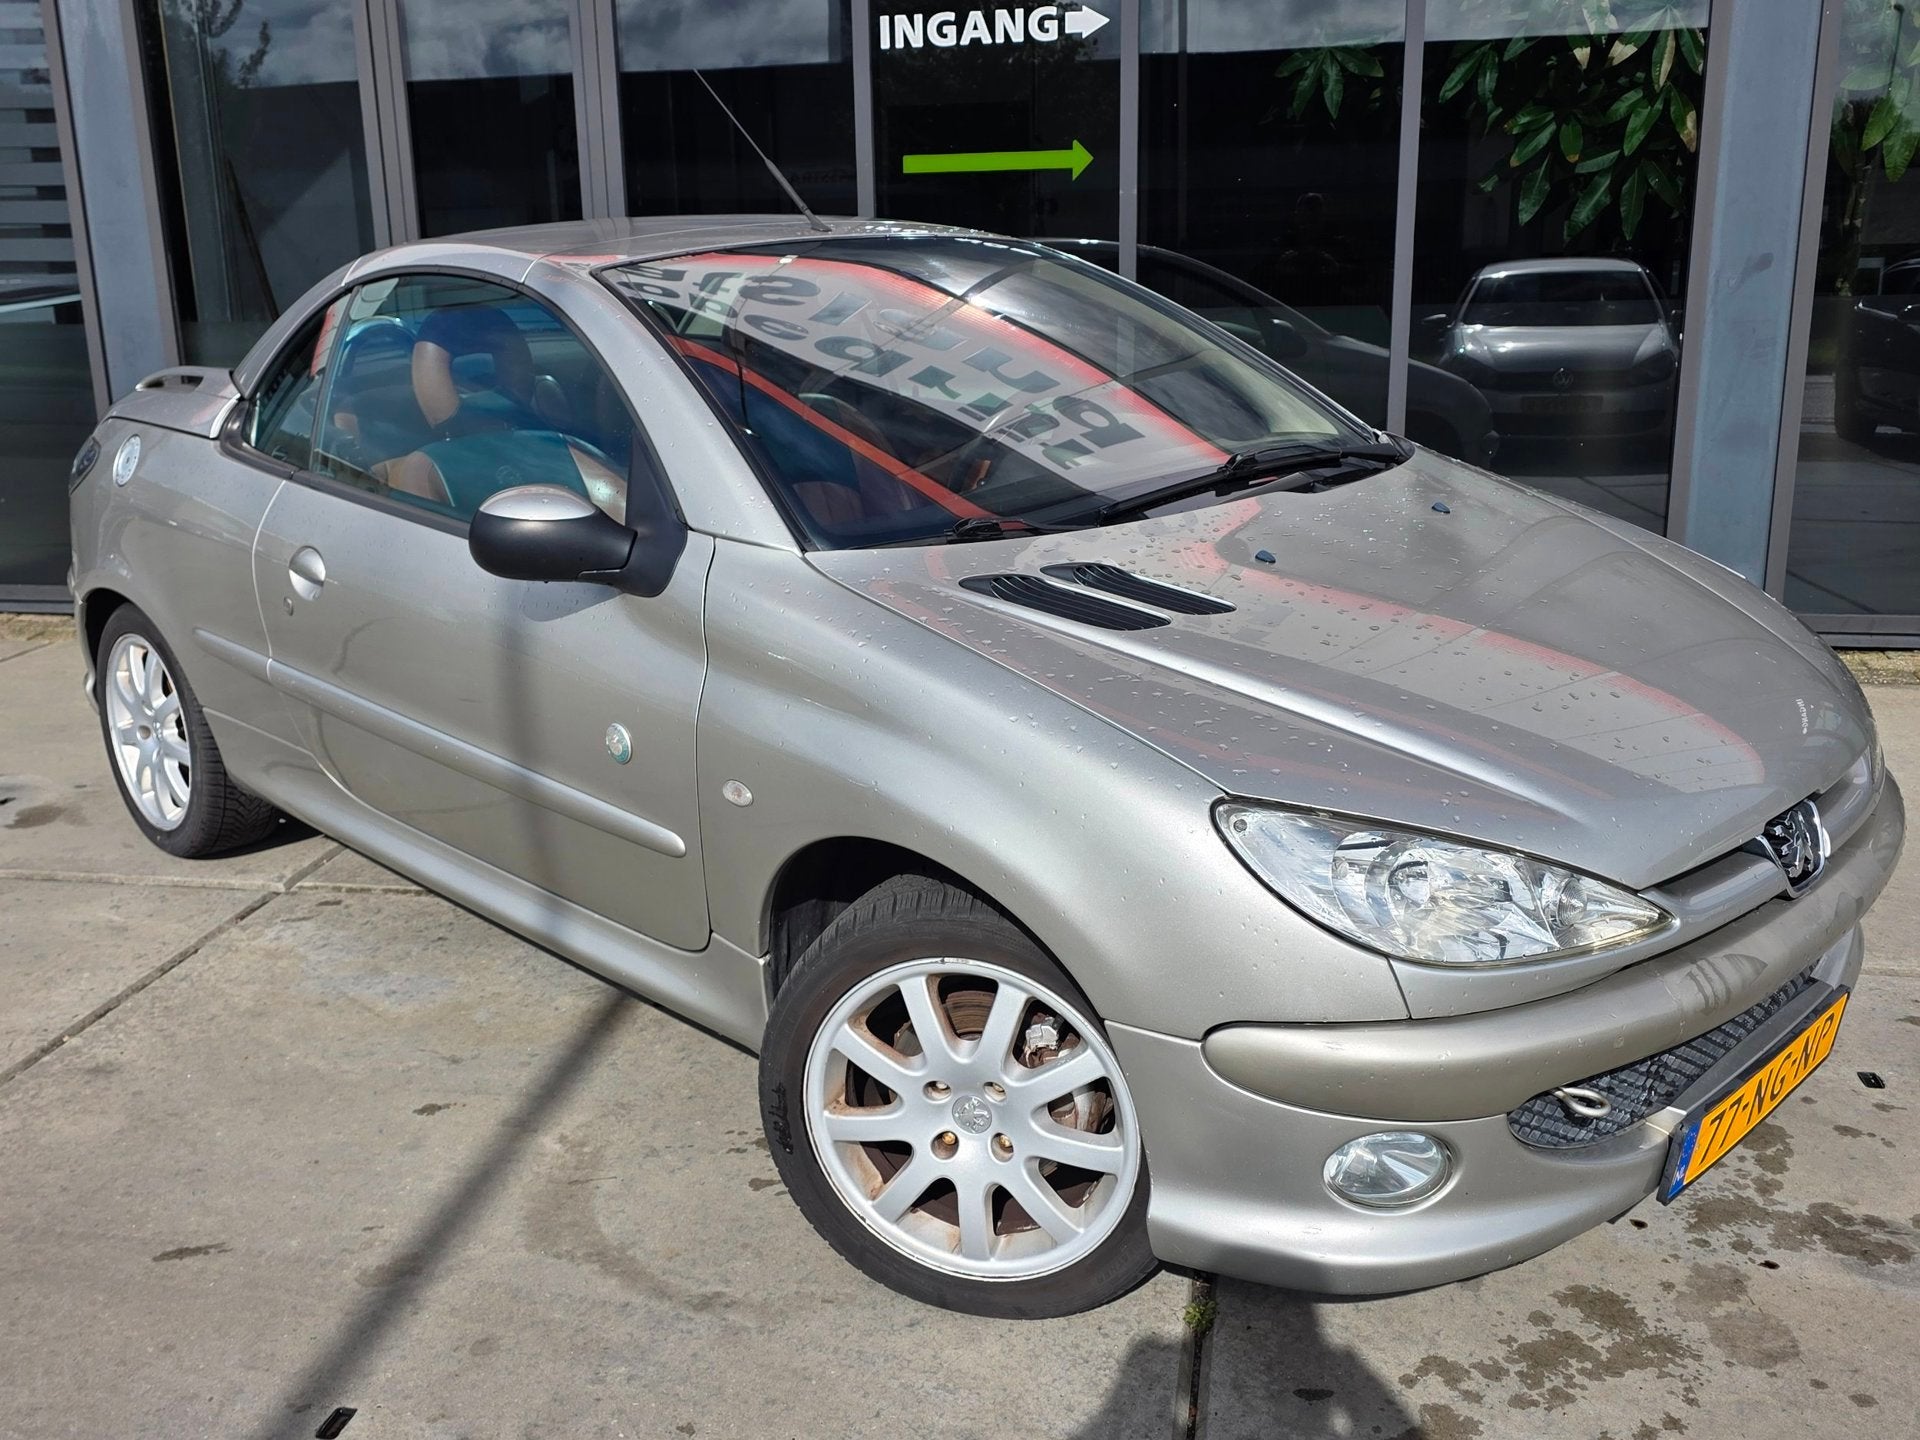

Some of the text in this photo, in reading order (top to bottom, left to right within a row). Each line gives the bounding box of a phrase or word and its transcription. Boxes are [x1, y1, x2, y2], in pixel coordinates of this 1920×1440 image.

[879, 6, 1059, 50] INGANG
[1698, 1012, 1835, 1166] 77-NG-NP
[1672, 1164, 1685, 1186] NL
